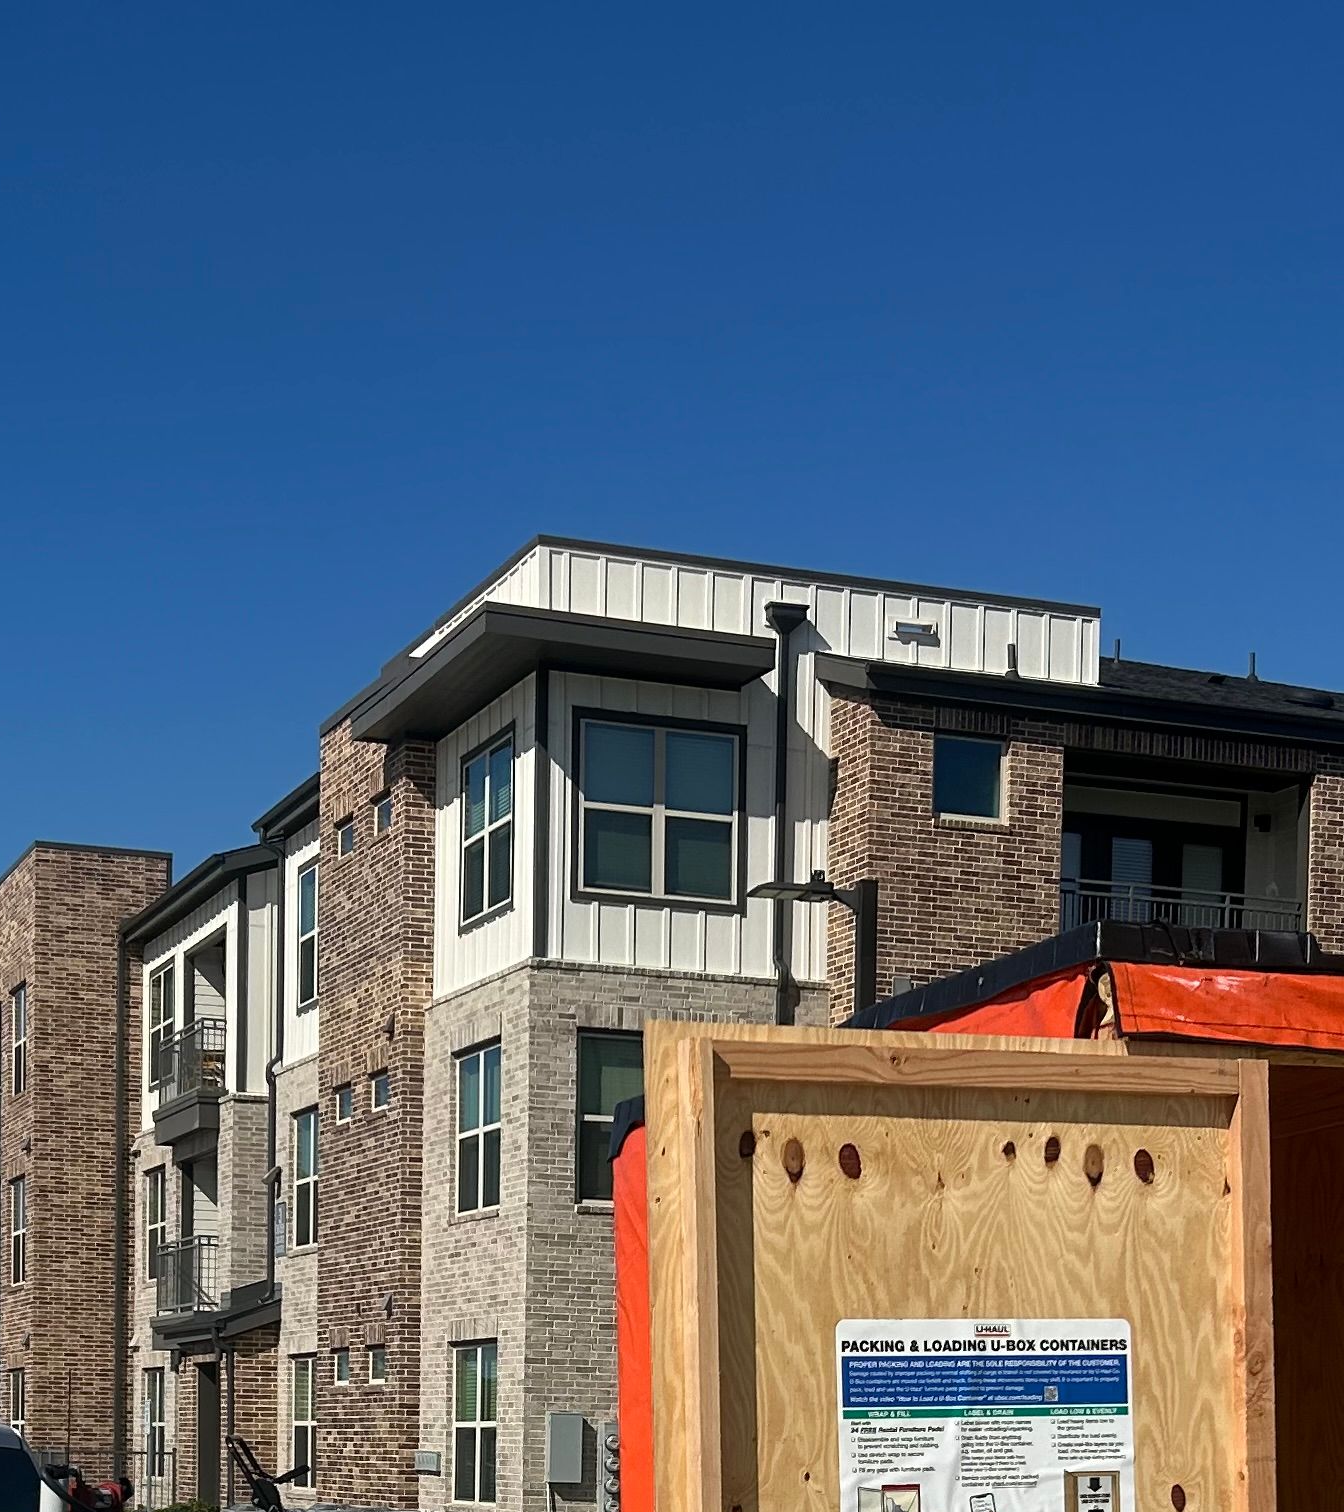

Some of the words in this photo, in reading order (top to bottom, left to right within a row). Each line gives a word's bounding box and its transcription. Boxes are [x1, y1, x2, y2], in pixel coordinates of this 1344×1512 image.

[976, 1325, 1009, 1333] U-HAUL
[841, 1340, 905, 1352] PACKING
[910, 1340, 919, 1352] &
[924, 1340, 986, 1352] LOADING
[991, 1340, 1035, 1351] U-BOX
[1040, 1339, 1127, 1351] CONTAINERS
